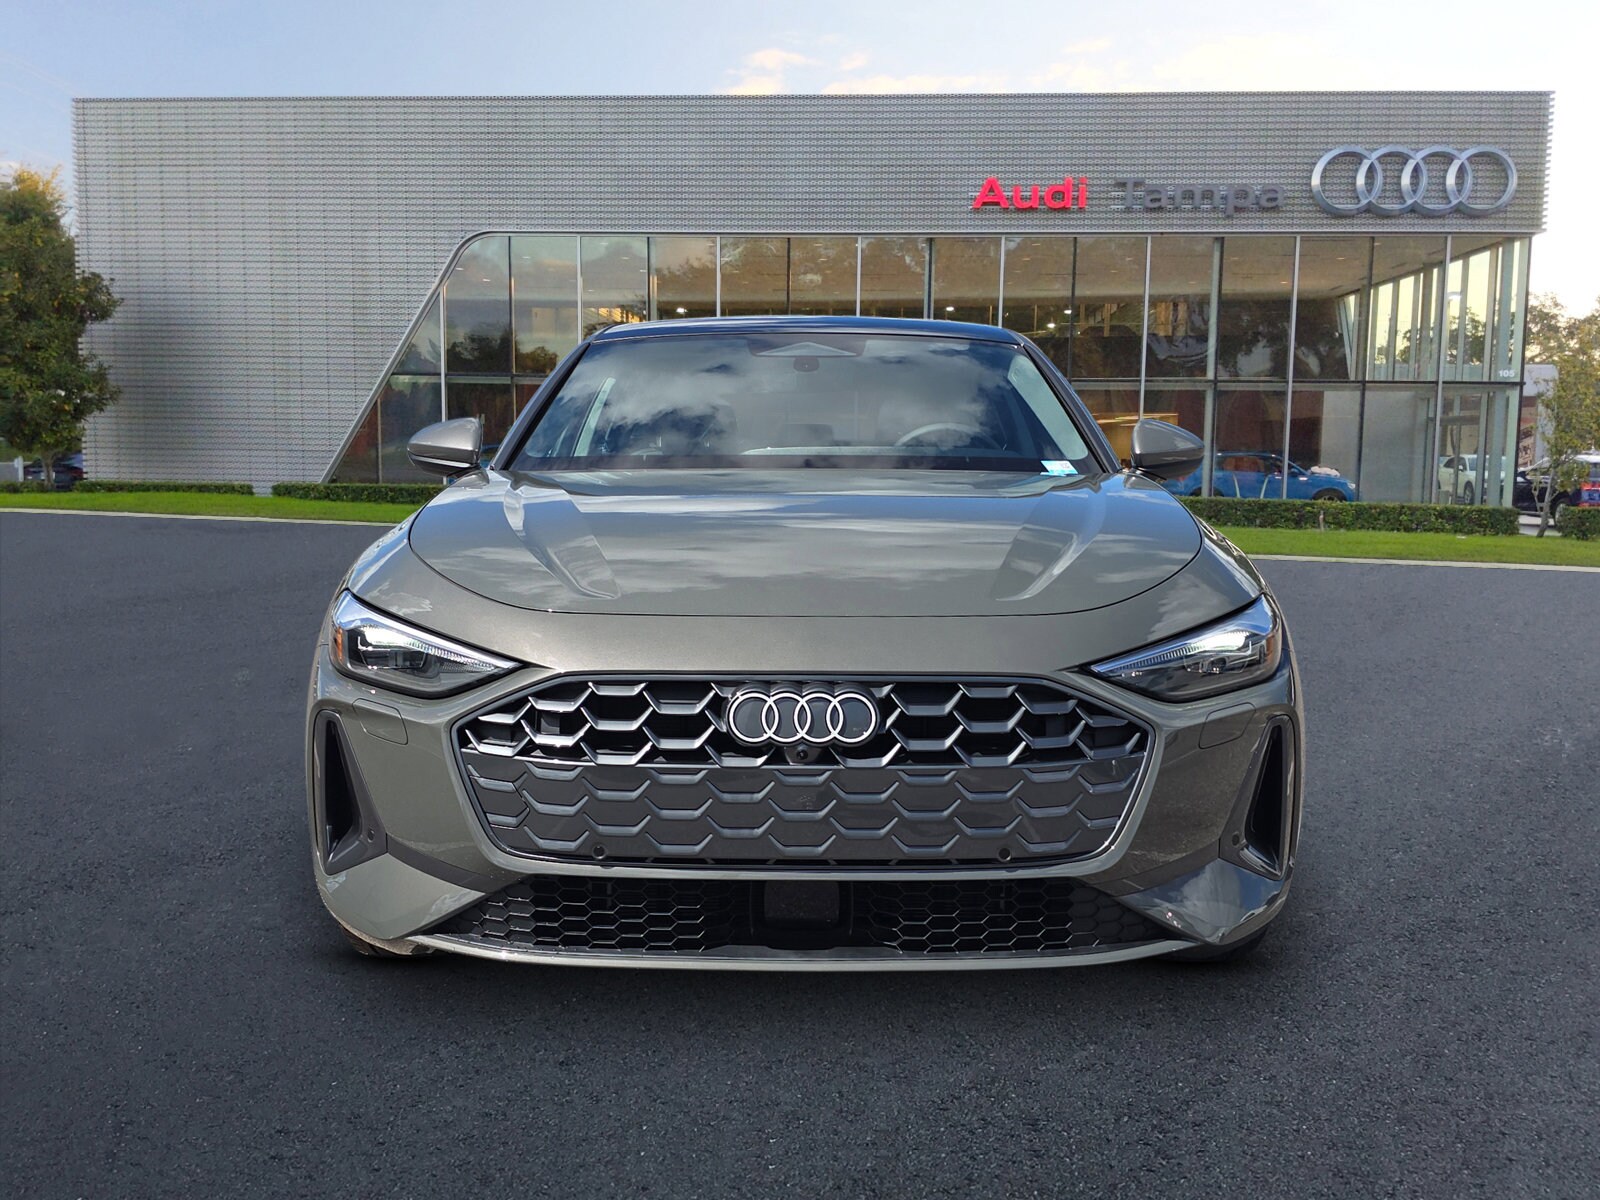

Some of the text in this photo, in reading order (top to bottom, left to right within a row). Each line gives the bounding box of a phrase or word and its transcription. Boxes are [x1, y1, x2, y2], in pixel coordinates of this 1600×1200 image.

[972, 177, 1284, 218] Audi Tampa
[1498, 369, 1515, 378] 105
